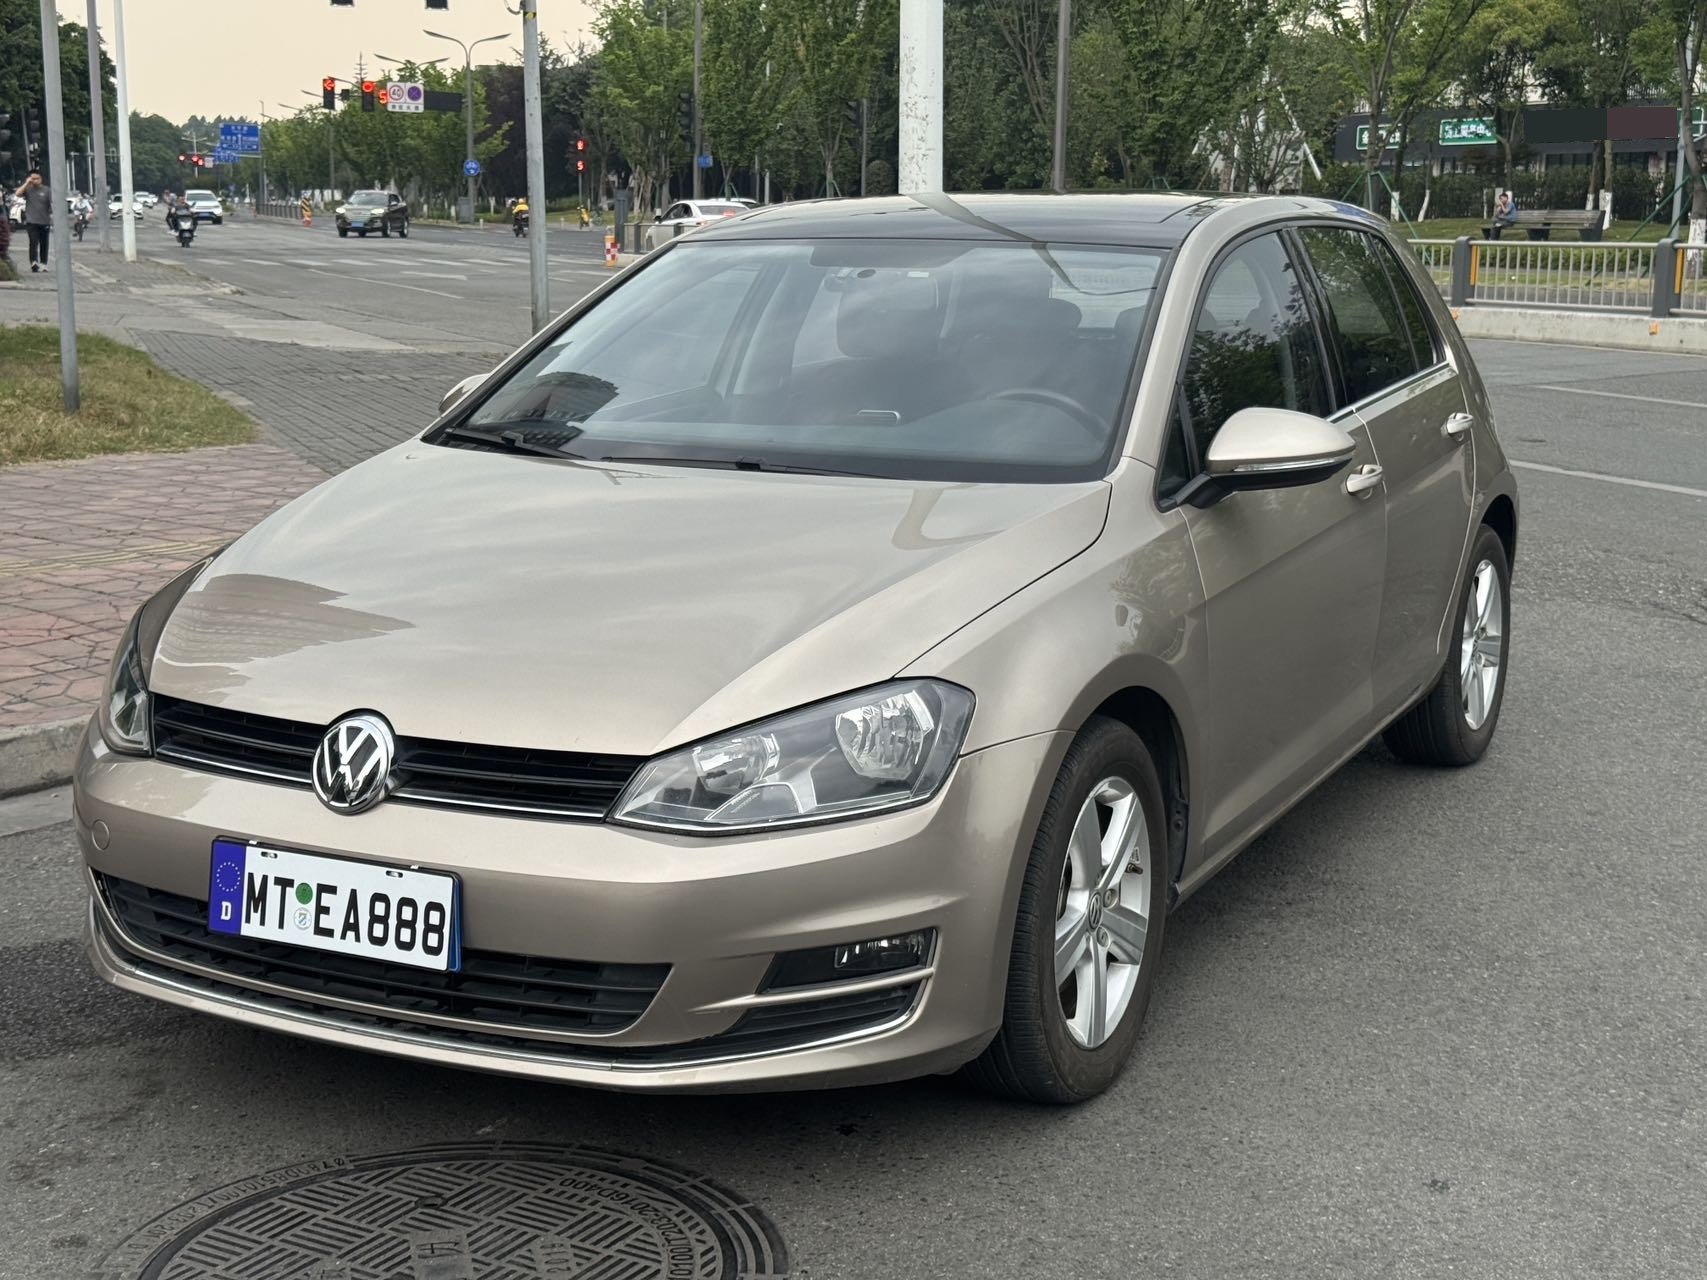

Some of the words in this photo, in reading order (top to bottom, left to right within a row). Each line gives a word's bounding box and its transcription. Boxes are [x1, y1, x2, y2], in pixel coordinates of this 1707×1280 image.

[378, 89, 388, 104] 5
[391, 89, 401, 98] 40
[220, 901, 233, 921] D
[244, 872, 295, 930] MT
[313, 883, 446, 956] EA888
